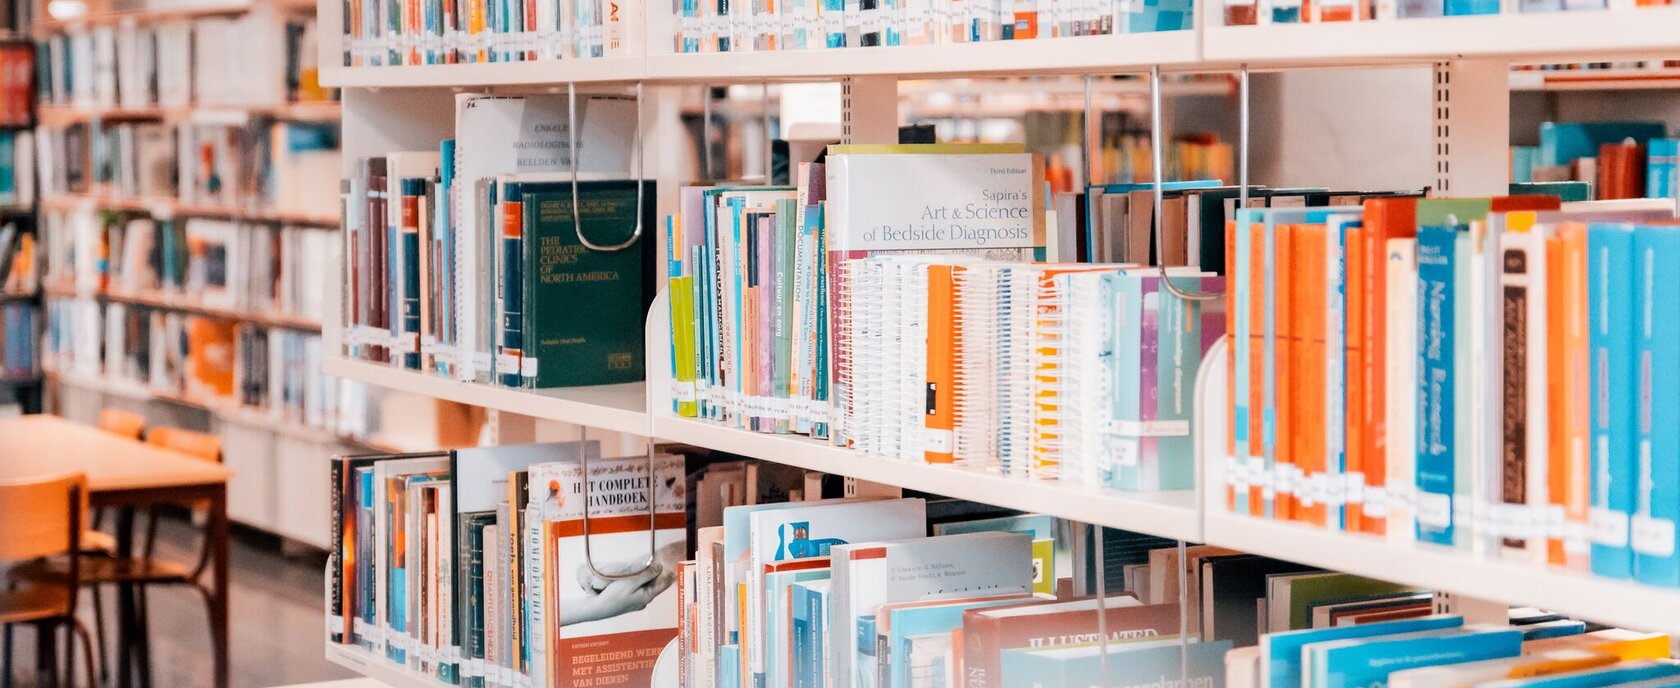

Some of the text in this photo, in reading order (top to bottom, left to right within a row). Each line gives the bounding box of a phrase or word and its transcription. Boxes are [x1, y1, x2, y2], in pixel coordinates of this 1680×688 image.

[517, 157, 578, 167] BEELDEN VA
[982, 189, 1028, 204] Sapira's
[921, 203, 1029, 220] Art & Science
[540, 237, 560, 246] THE
[863, 223, 1029, 246] of Bedside Diagnosis
[540, 255, 577, 265] CLINICS
[795, 224, 804, 302] DOCUMENTATION
[540, 265, 553, 274] OF
[540, 271, 619, 283] NORTH AMERICA
[776, 271, 784, 306] Cultuur
[775, 319, 783, 338] zorg
[1427, 280, 1447, 360] Nursing
[1430, 367, 1447, 456] Research
[573, 482, 596, 494] HT
[531, 527, 541, 625] HOMEOPATHIE
[487, 569, 495, 662] QUANTUMGENEZI
[572, 650, 633, 665] BEGELEIDEND
[572, 659, 655, 677] MET ASSISTENTIE
[573, 674, 628, 688] VAN DIEREN
